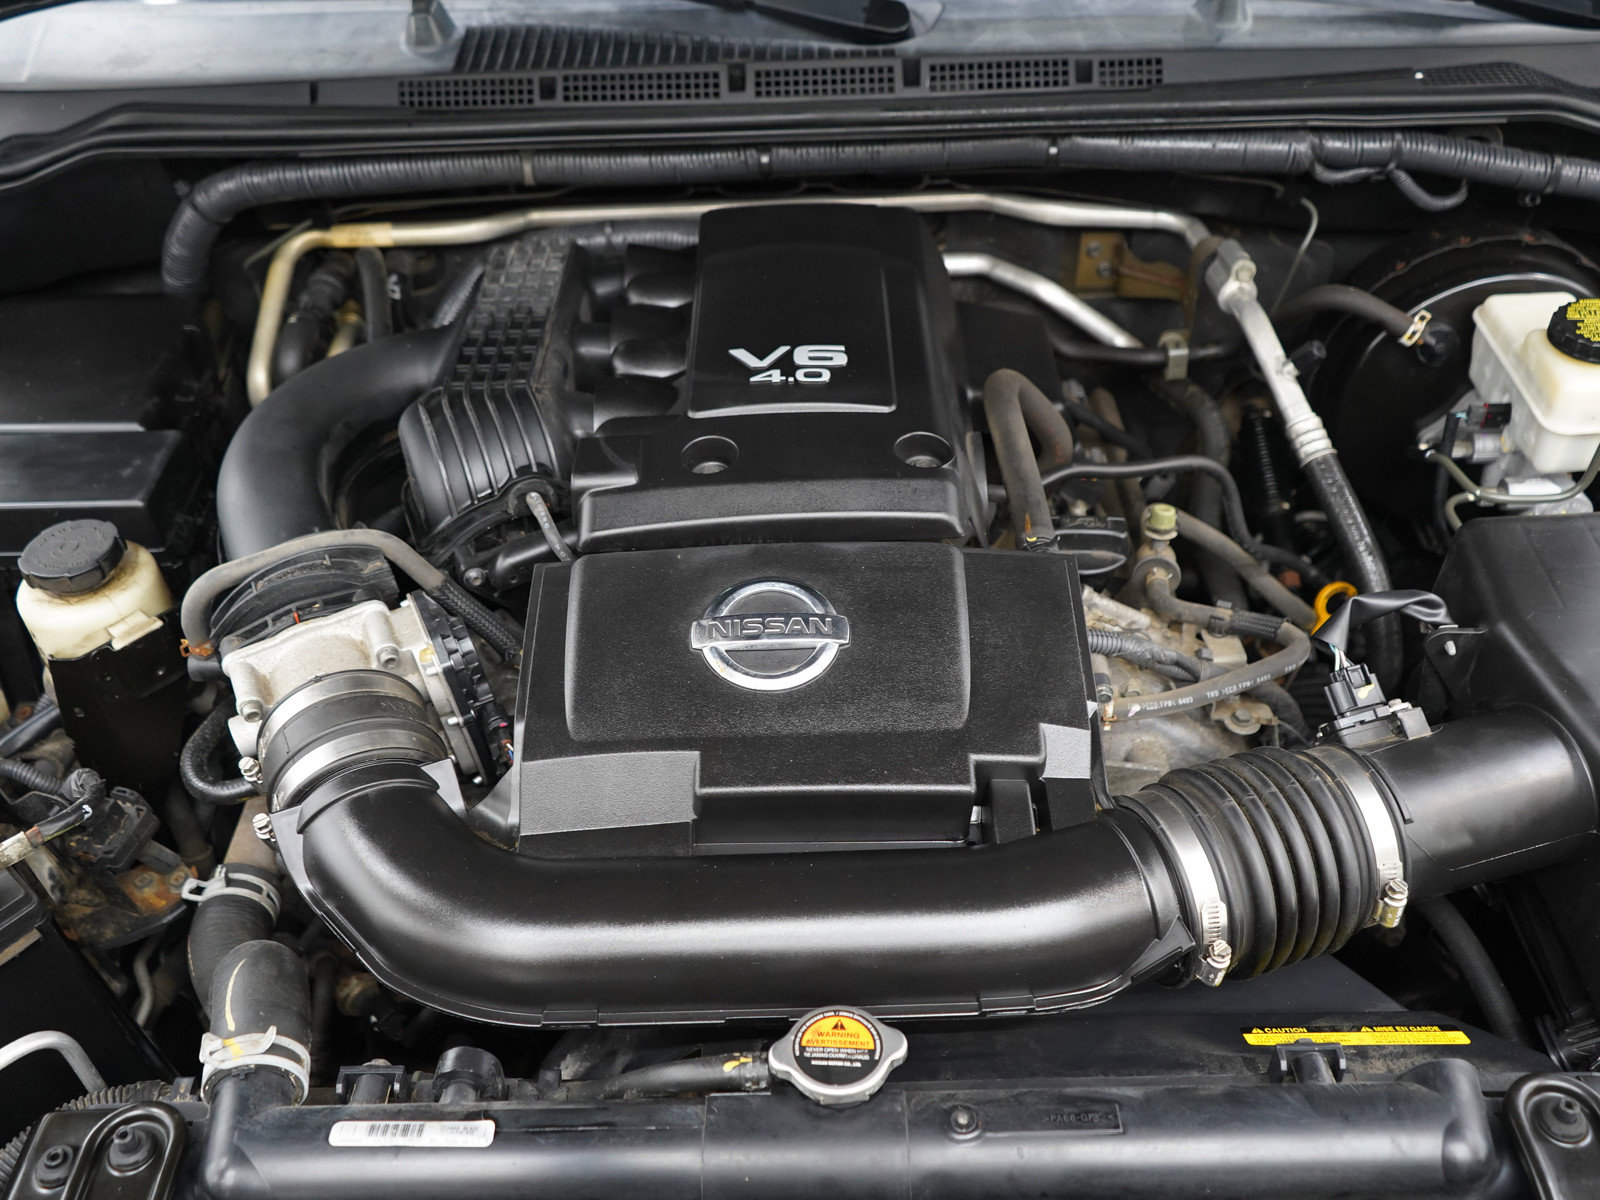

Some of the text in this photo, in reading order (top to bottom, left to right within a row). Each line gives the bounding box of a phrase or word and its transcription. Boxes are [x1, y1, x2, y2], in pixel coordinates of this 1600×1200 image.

[728, 345, 848, 368] V6
[749, 368, 831, 384] 4.0
[708, 617, 832, 638] NISSAN
[806, 1039, 870, 1047] AVERTISSEMENT
[817, 1031, 860, 1039] WARNING
